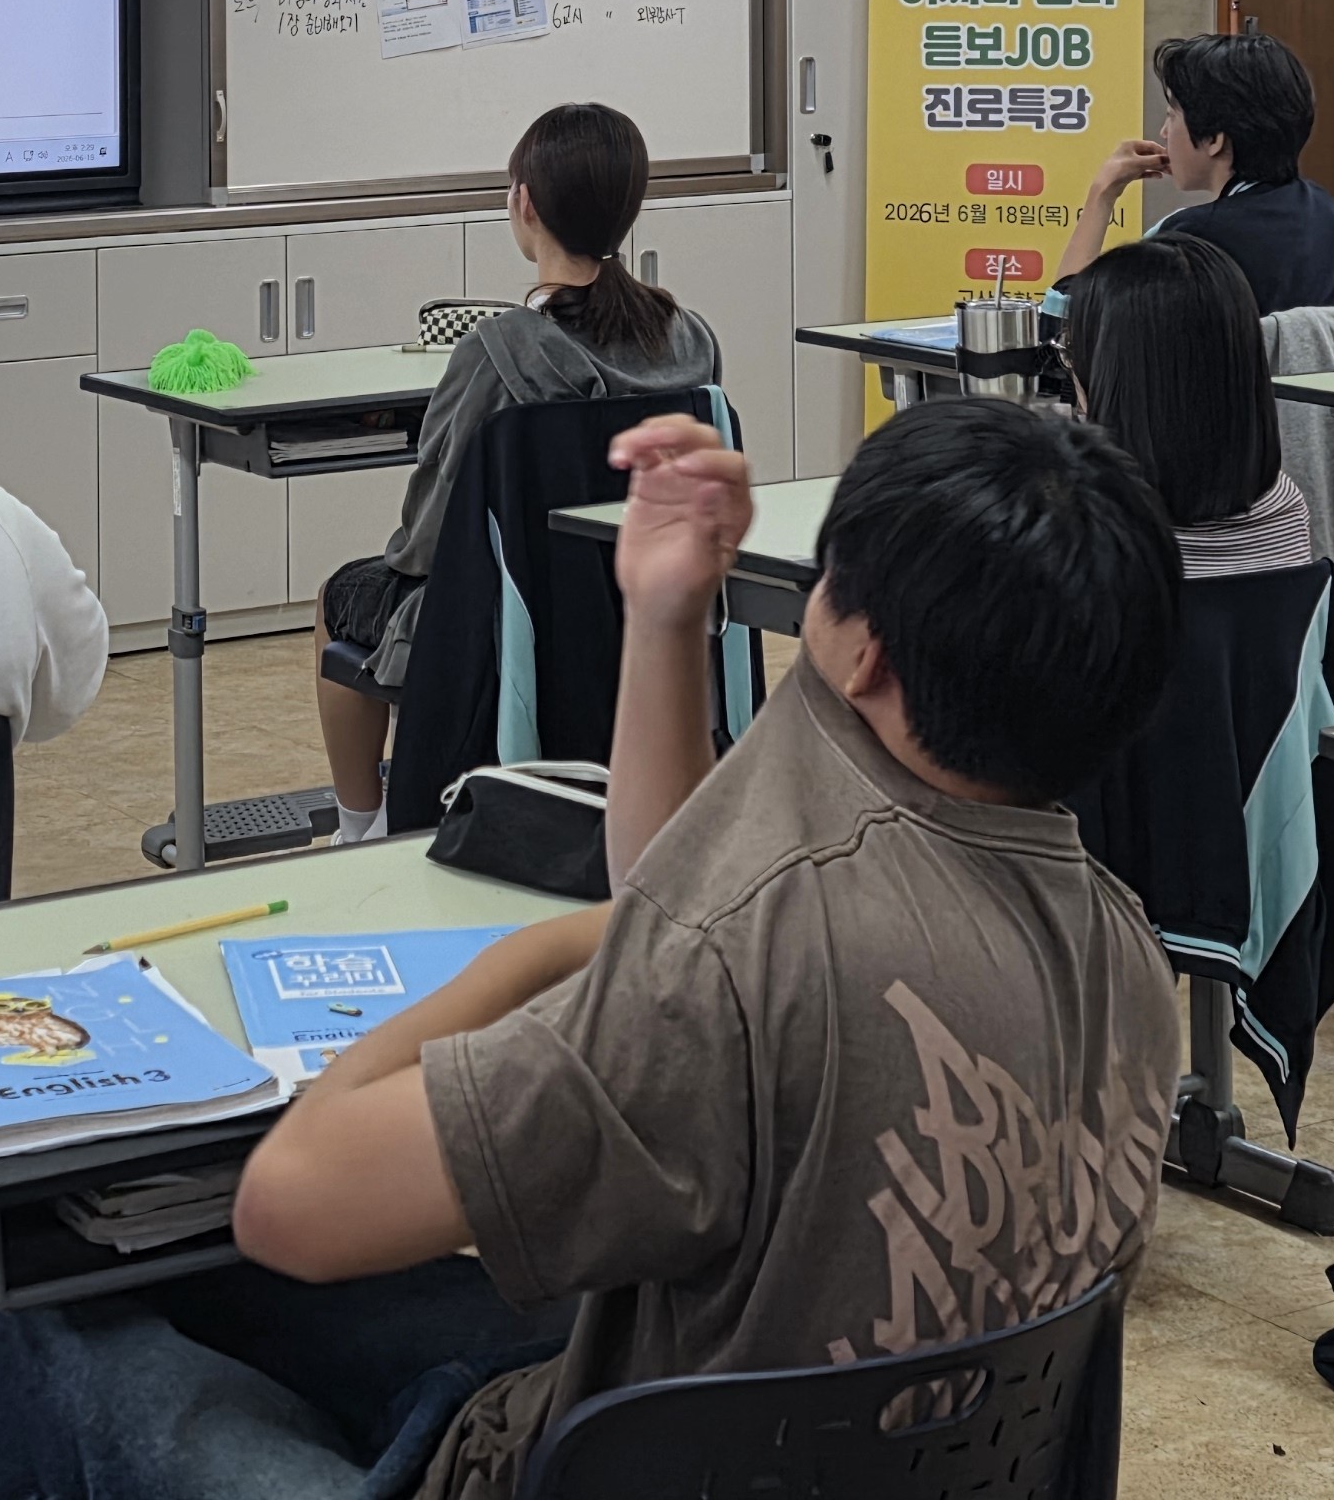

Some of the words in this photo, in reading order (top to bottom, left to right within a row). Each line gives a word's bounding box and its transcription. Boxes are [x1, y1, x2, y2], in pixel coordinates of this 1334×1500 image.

[552, 2, 583, 29] 6교시
[923, 25, 1091, 67] 듣보JOB
[924, 86, 1091, 130] 진로특강
[987, 170, 1022, 191] 일시
[884, 202, 950, 223] 2026년
[957, 204, 987, 225] 6월
[995, 205, 1069, 227] 18일(목)
[294, 1028, 367, 1043] Englis
[142, 1068, 172, 1085] 3
